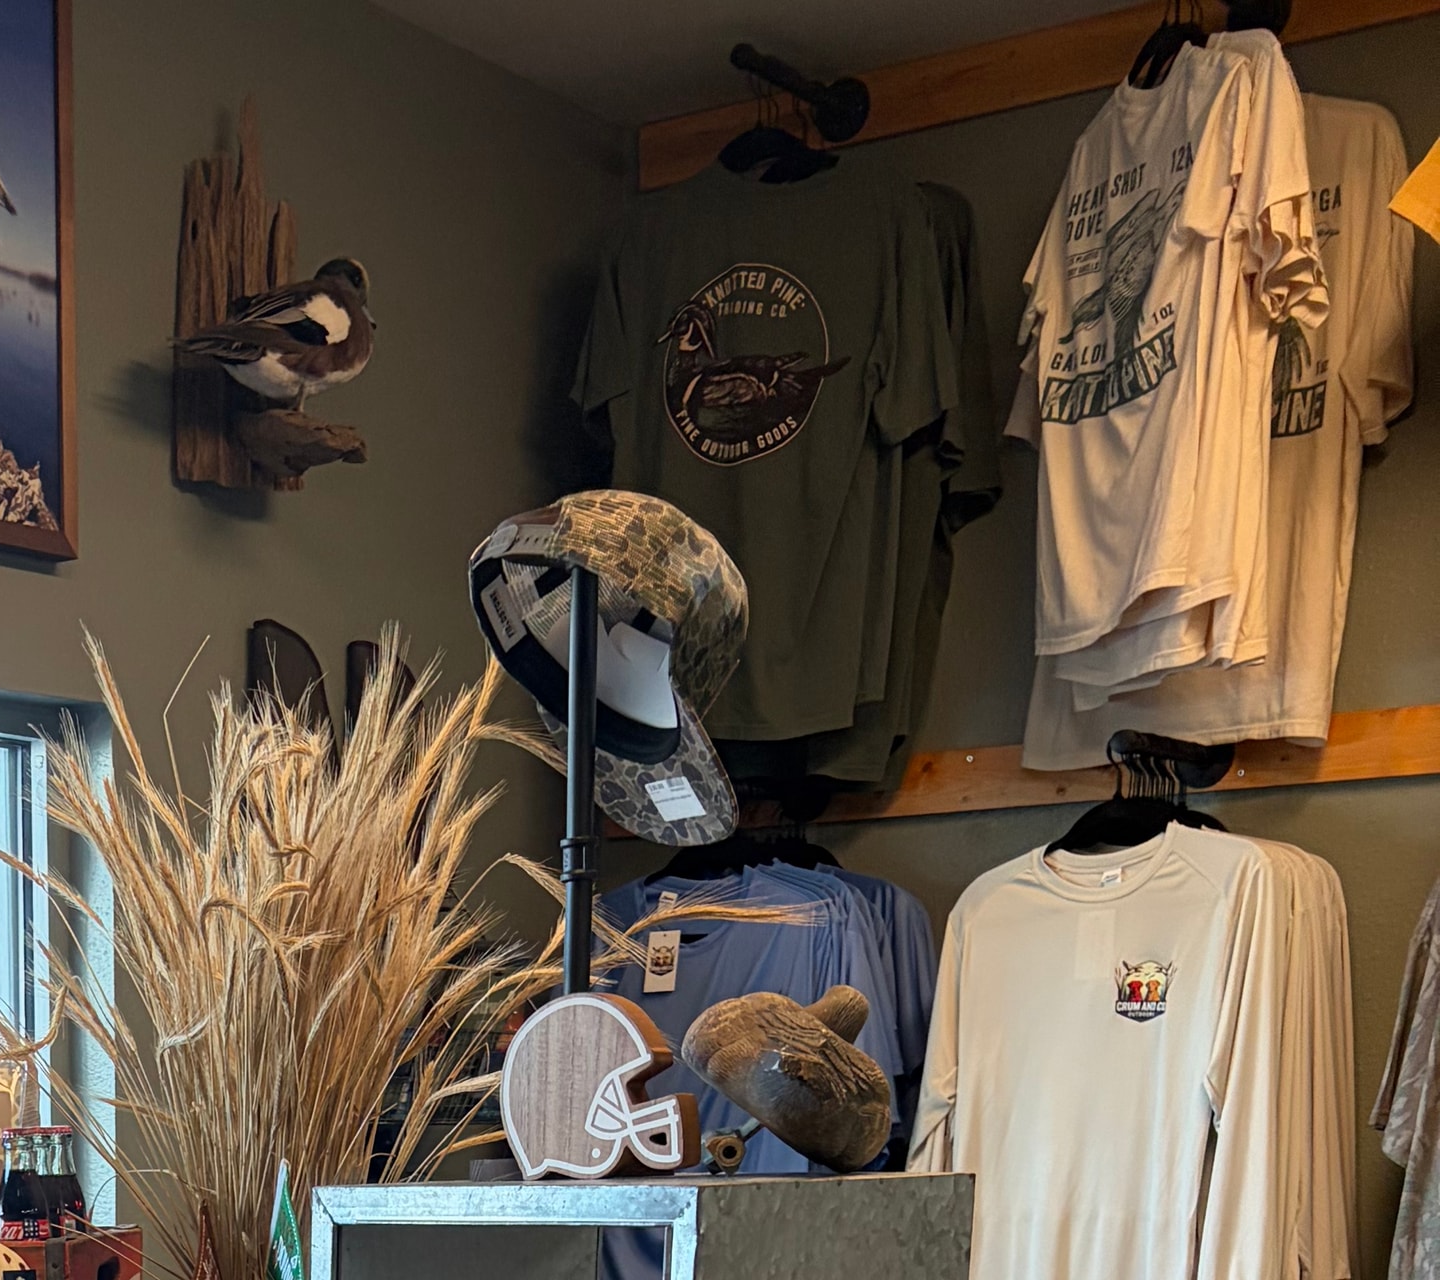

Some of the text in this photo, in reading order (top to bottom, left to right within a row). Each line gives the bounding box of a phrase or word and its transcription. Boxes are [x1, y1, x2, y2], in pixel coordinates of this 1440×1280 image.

[1110, 163, 1147, 199] SHOT
[705, 272, 805, 310] KNOTTED PINE
[676, 409, 700, 442] FINE
[757, 416, 797, 449] GOODS
[1116, 1001, 1140, 1012] CRUM
[1141, 1001, 1156, 1012] AND
